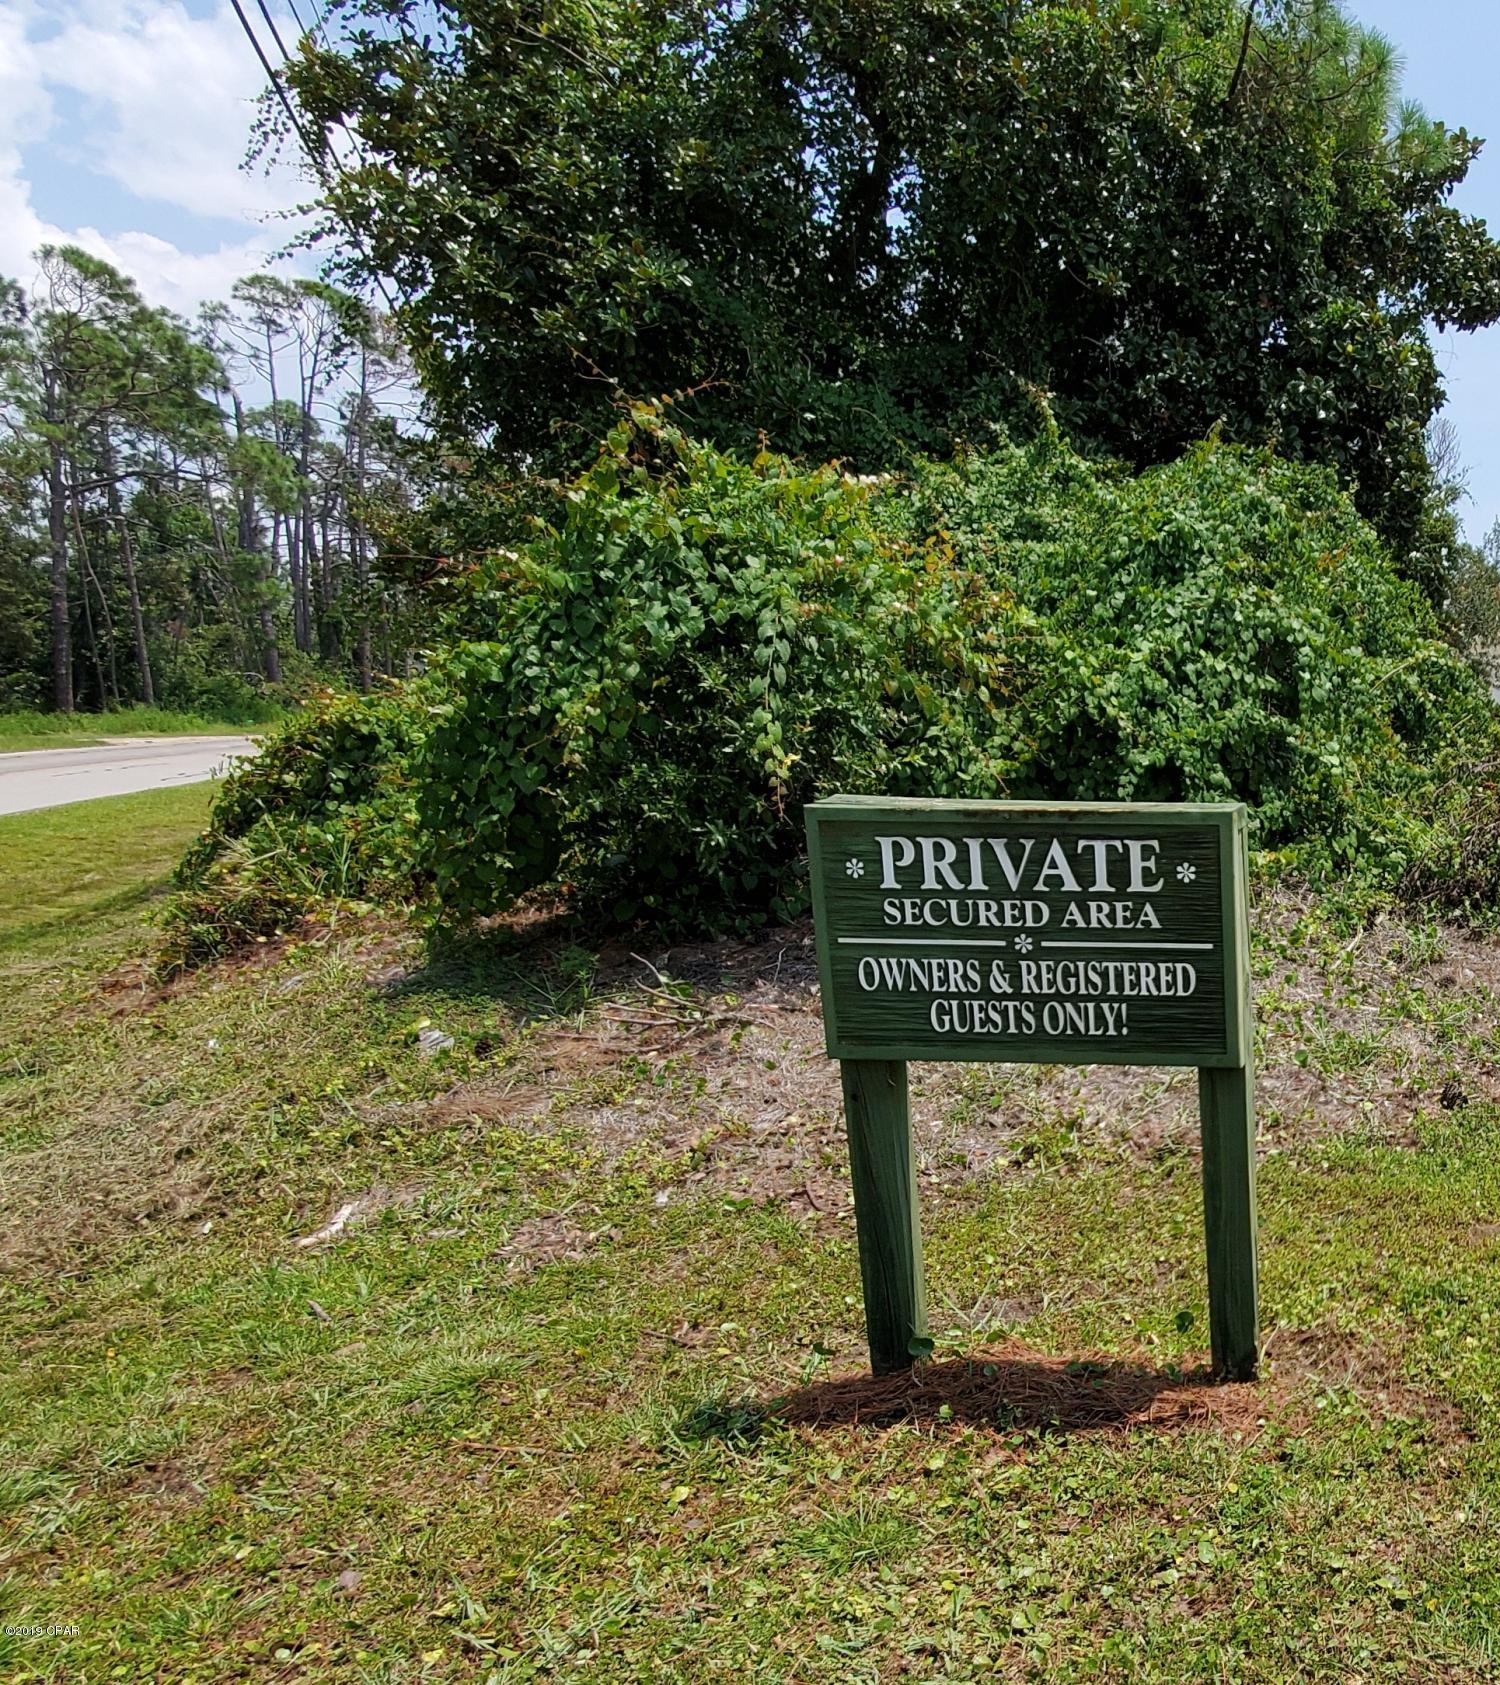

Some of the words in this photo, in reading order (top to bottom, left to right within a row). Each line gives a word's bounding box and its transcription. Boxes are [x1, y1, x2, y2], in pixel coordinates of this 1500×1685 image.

[874, 836, 1164, 892] PRIVATE
[883, 898, 1050, 926] SECURED
[1060, 901, 1163, 929] AREA
[858, 957, 981, 993] OWNERS
[989, 960, 1014, 994] &
[1018, 960, 1197, 997] REGISTERED
[930, 999, 1036, 1034] GUESTS
[1042, 1001, 1129, 1036] ONLY!
